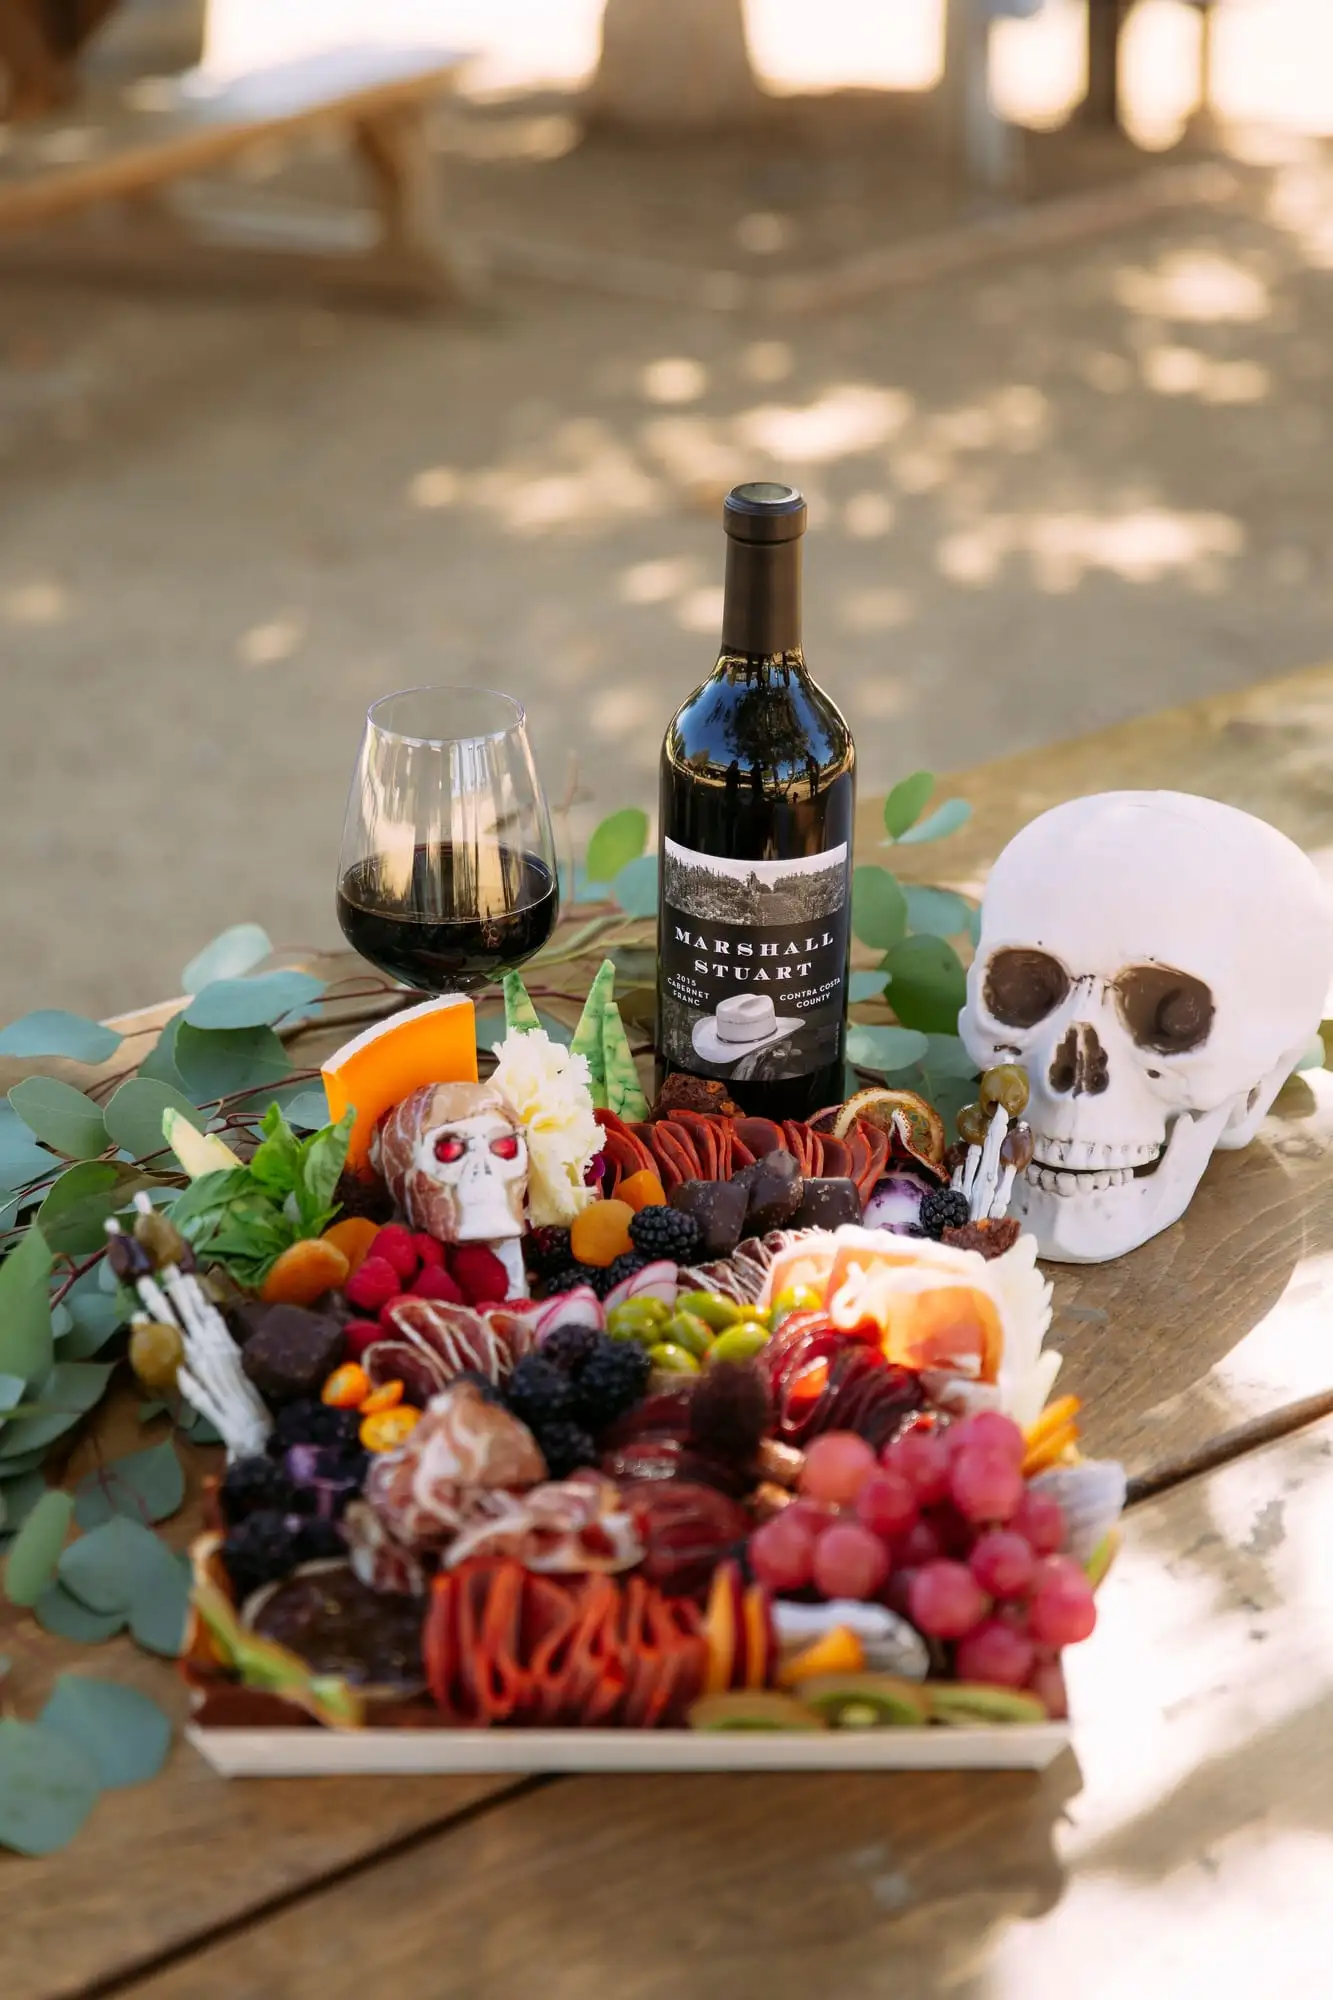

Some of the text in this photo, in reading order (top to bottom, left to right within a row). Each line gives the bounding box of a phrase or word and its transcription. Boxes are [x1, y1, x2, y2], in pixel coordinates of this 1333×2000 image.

[675, 926, 834, 956] MARSHALL
[676, 973, 697, 987] 2015
[694, 959, 812, 981] STUART
[667, 977, 710, 1000] CABERNET
[673, 990, 700, 1006] FRANC
[779, 977, 841, 1001] CONTRA COSTA
[796, 992, 831, 1009] COUNTY
